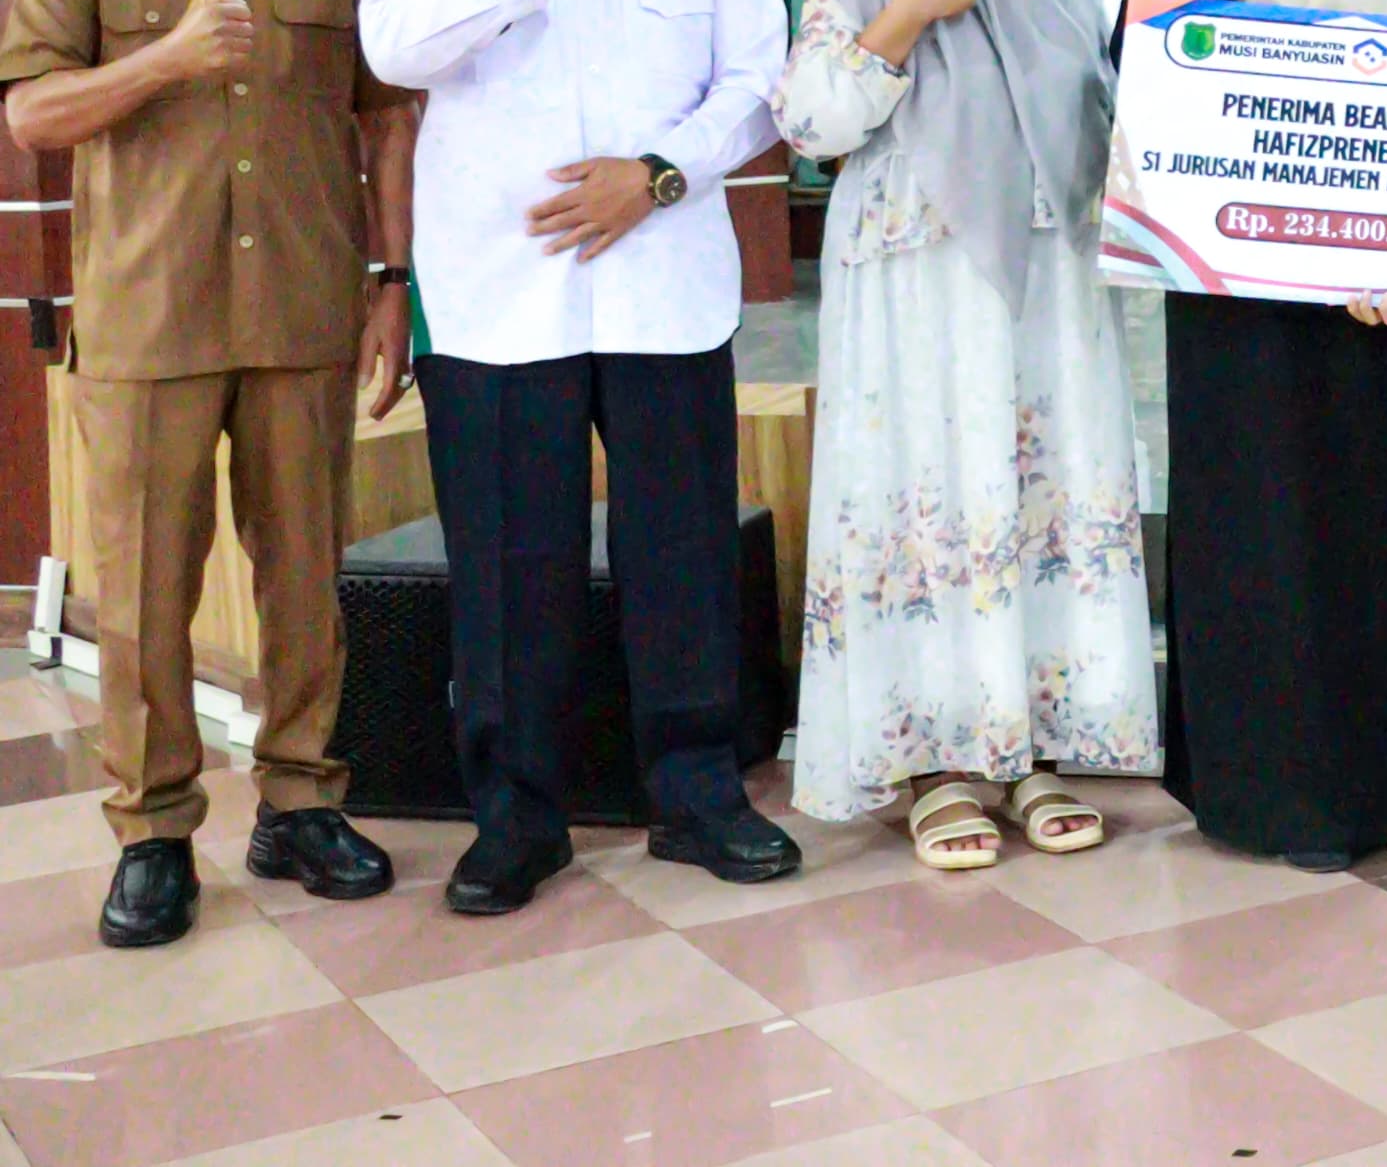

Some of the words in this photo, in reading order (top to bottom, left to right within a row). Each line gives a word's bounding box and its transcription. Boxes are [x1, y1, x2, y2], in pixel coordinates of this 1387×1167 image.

[1219, 44, 1257, 59] MUSI
[1261, 48, 1345, 66] BANYUASIN
[1220, 32, 1285, 47] PEMERINTAH
[1287, 38, 1347, 52] KABUPATEN
[1222, 93, 1335, 126] PENERIMA
[1142, 152, 1160, 172] S1
[1168, 154, 1254, 181] JURUSAN
[1262, 163, 1379, 191] MANAJEMEN
[1225, 206, 1275, 239] Rp.
